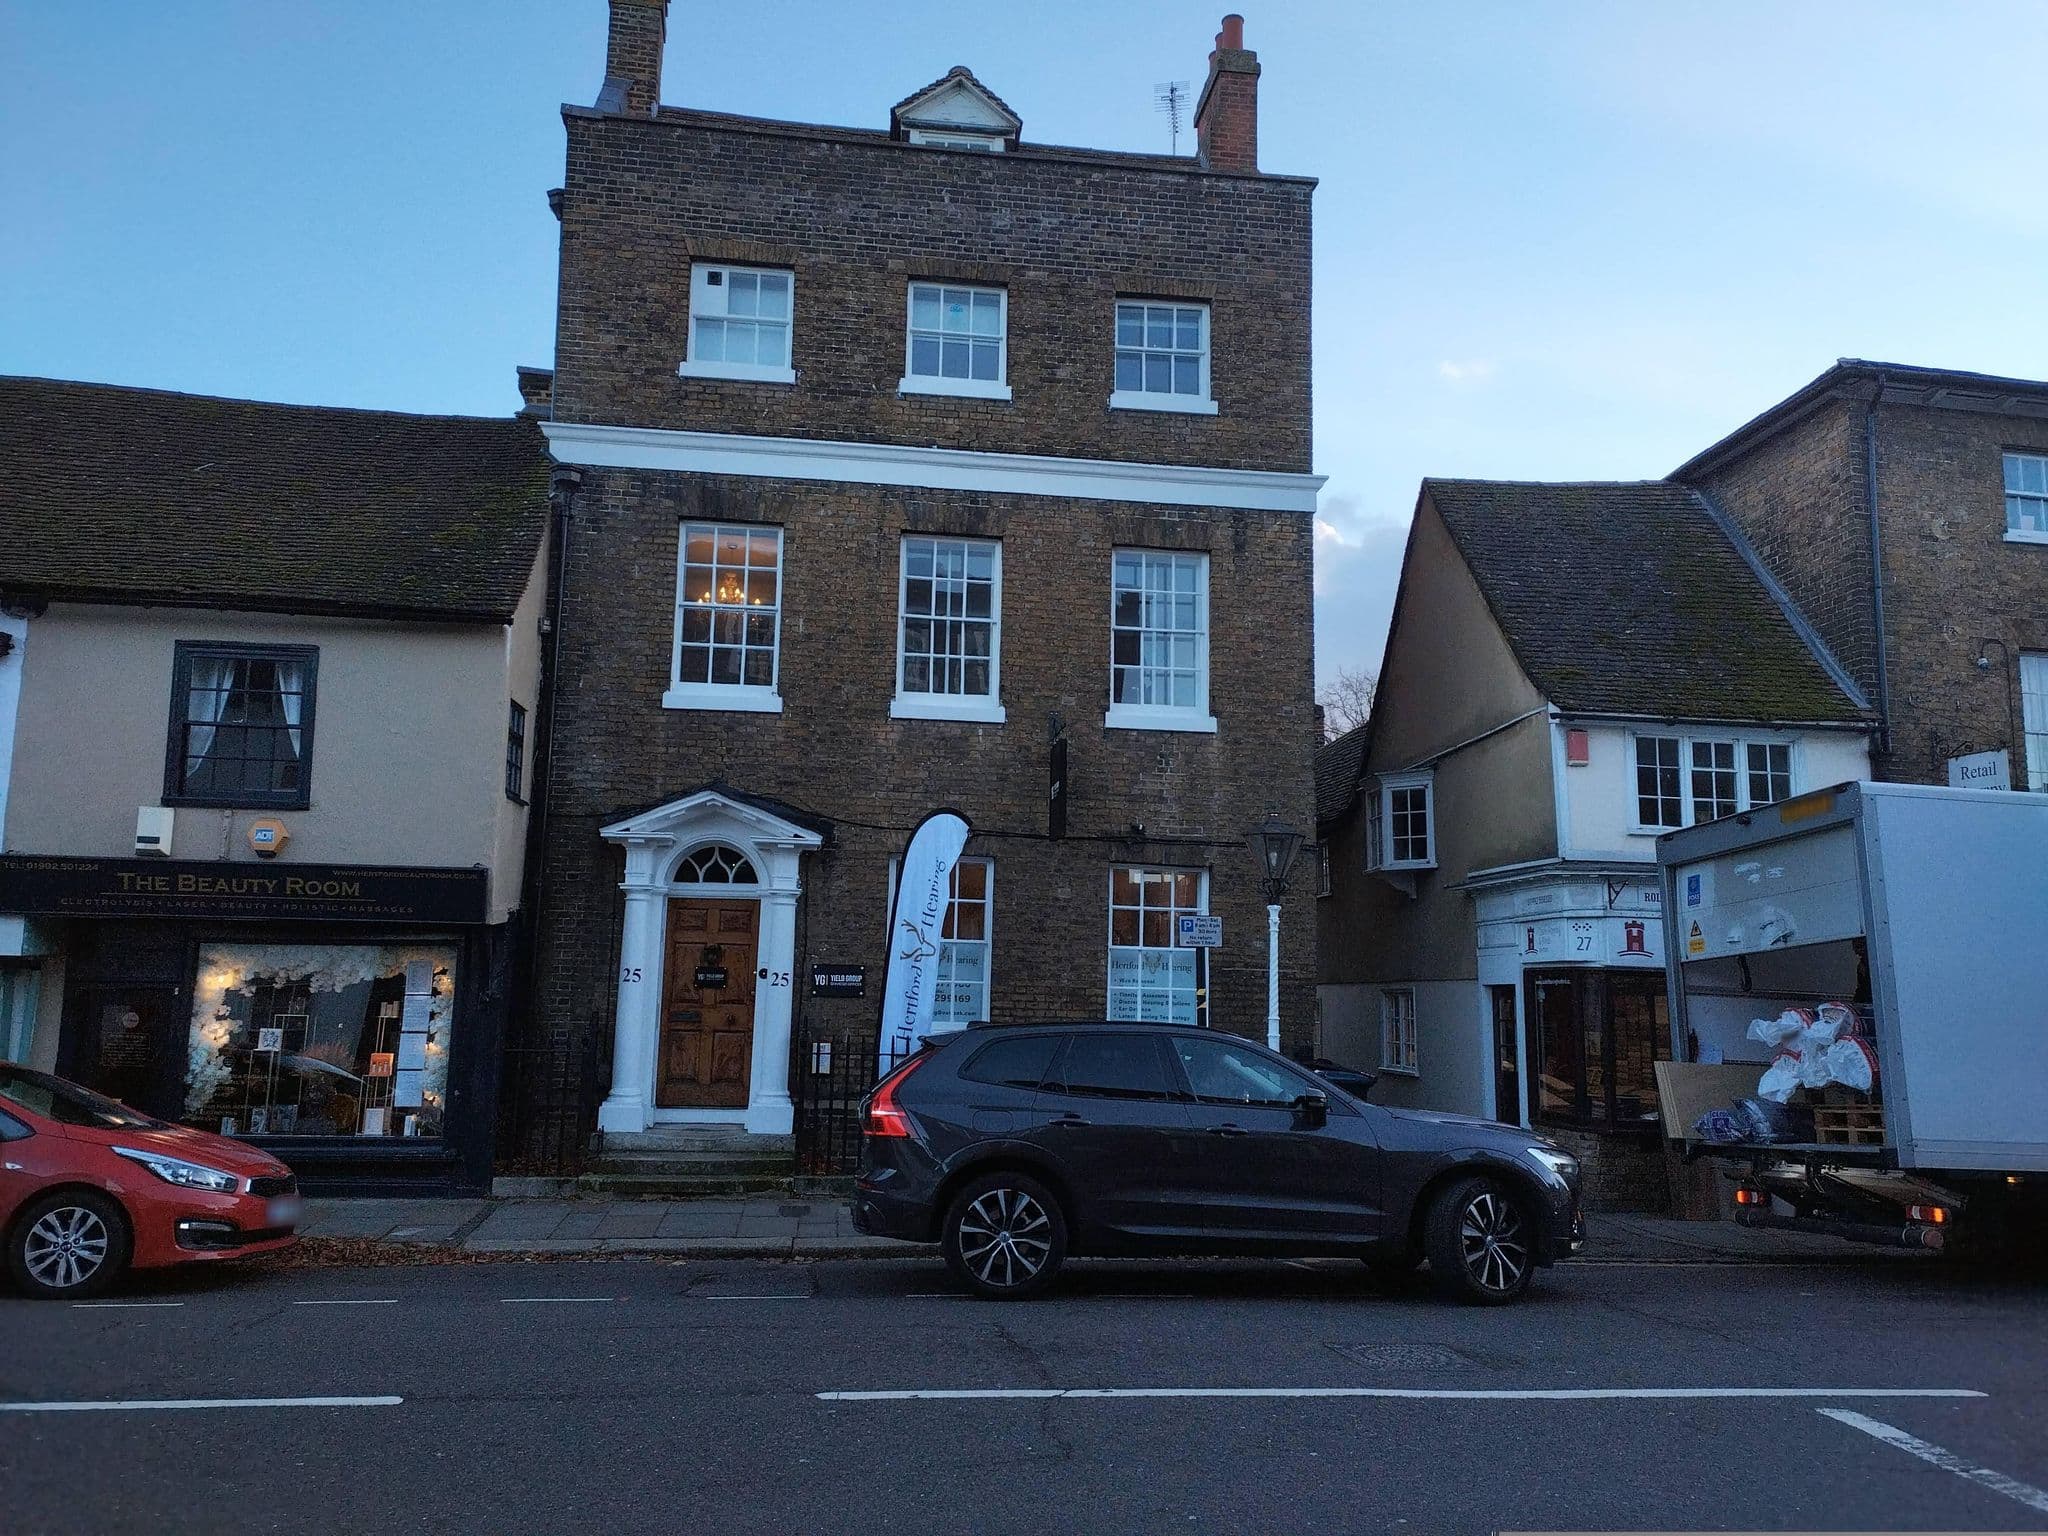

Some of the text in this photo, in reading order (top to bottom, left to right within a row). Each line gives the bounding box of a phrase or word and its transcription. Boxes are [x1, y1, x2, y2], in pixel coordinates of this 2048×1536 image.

[1960, 761, 1997, 780] Retail
[256, 831, 273, 840] ADT
[117, 871, 361, 896] THE BEAUTY ROOM
[1183, 920, 1192, 931] P
[896, 857, 947, 1043] Hertford Hearing
[1577, 936, 1592, 951] 27
[947, 954, 979, 967] Haring
[1162, 962, 1192, 974] Haring
[622, 967, 642, 983] 25
[771, 971, 790, 987] 25
[814, 974, 826, 986] YG
